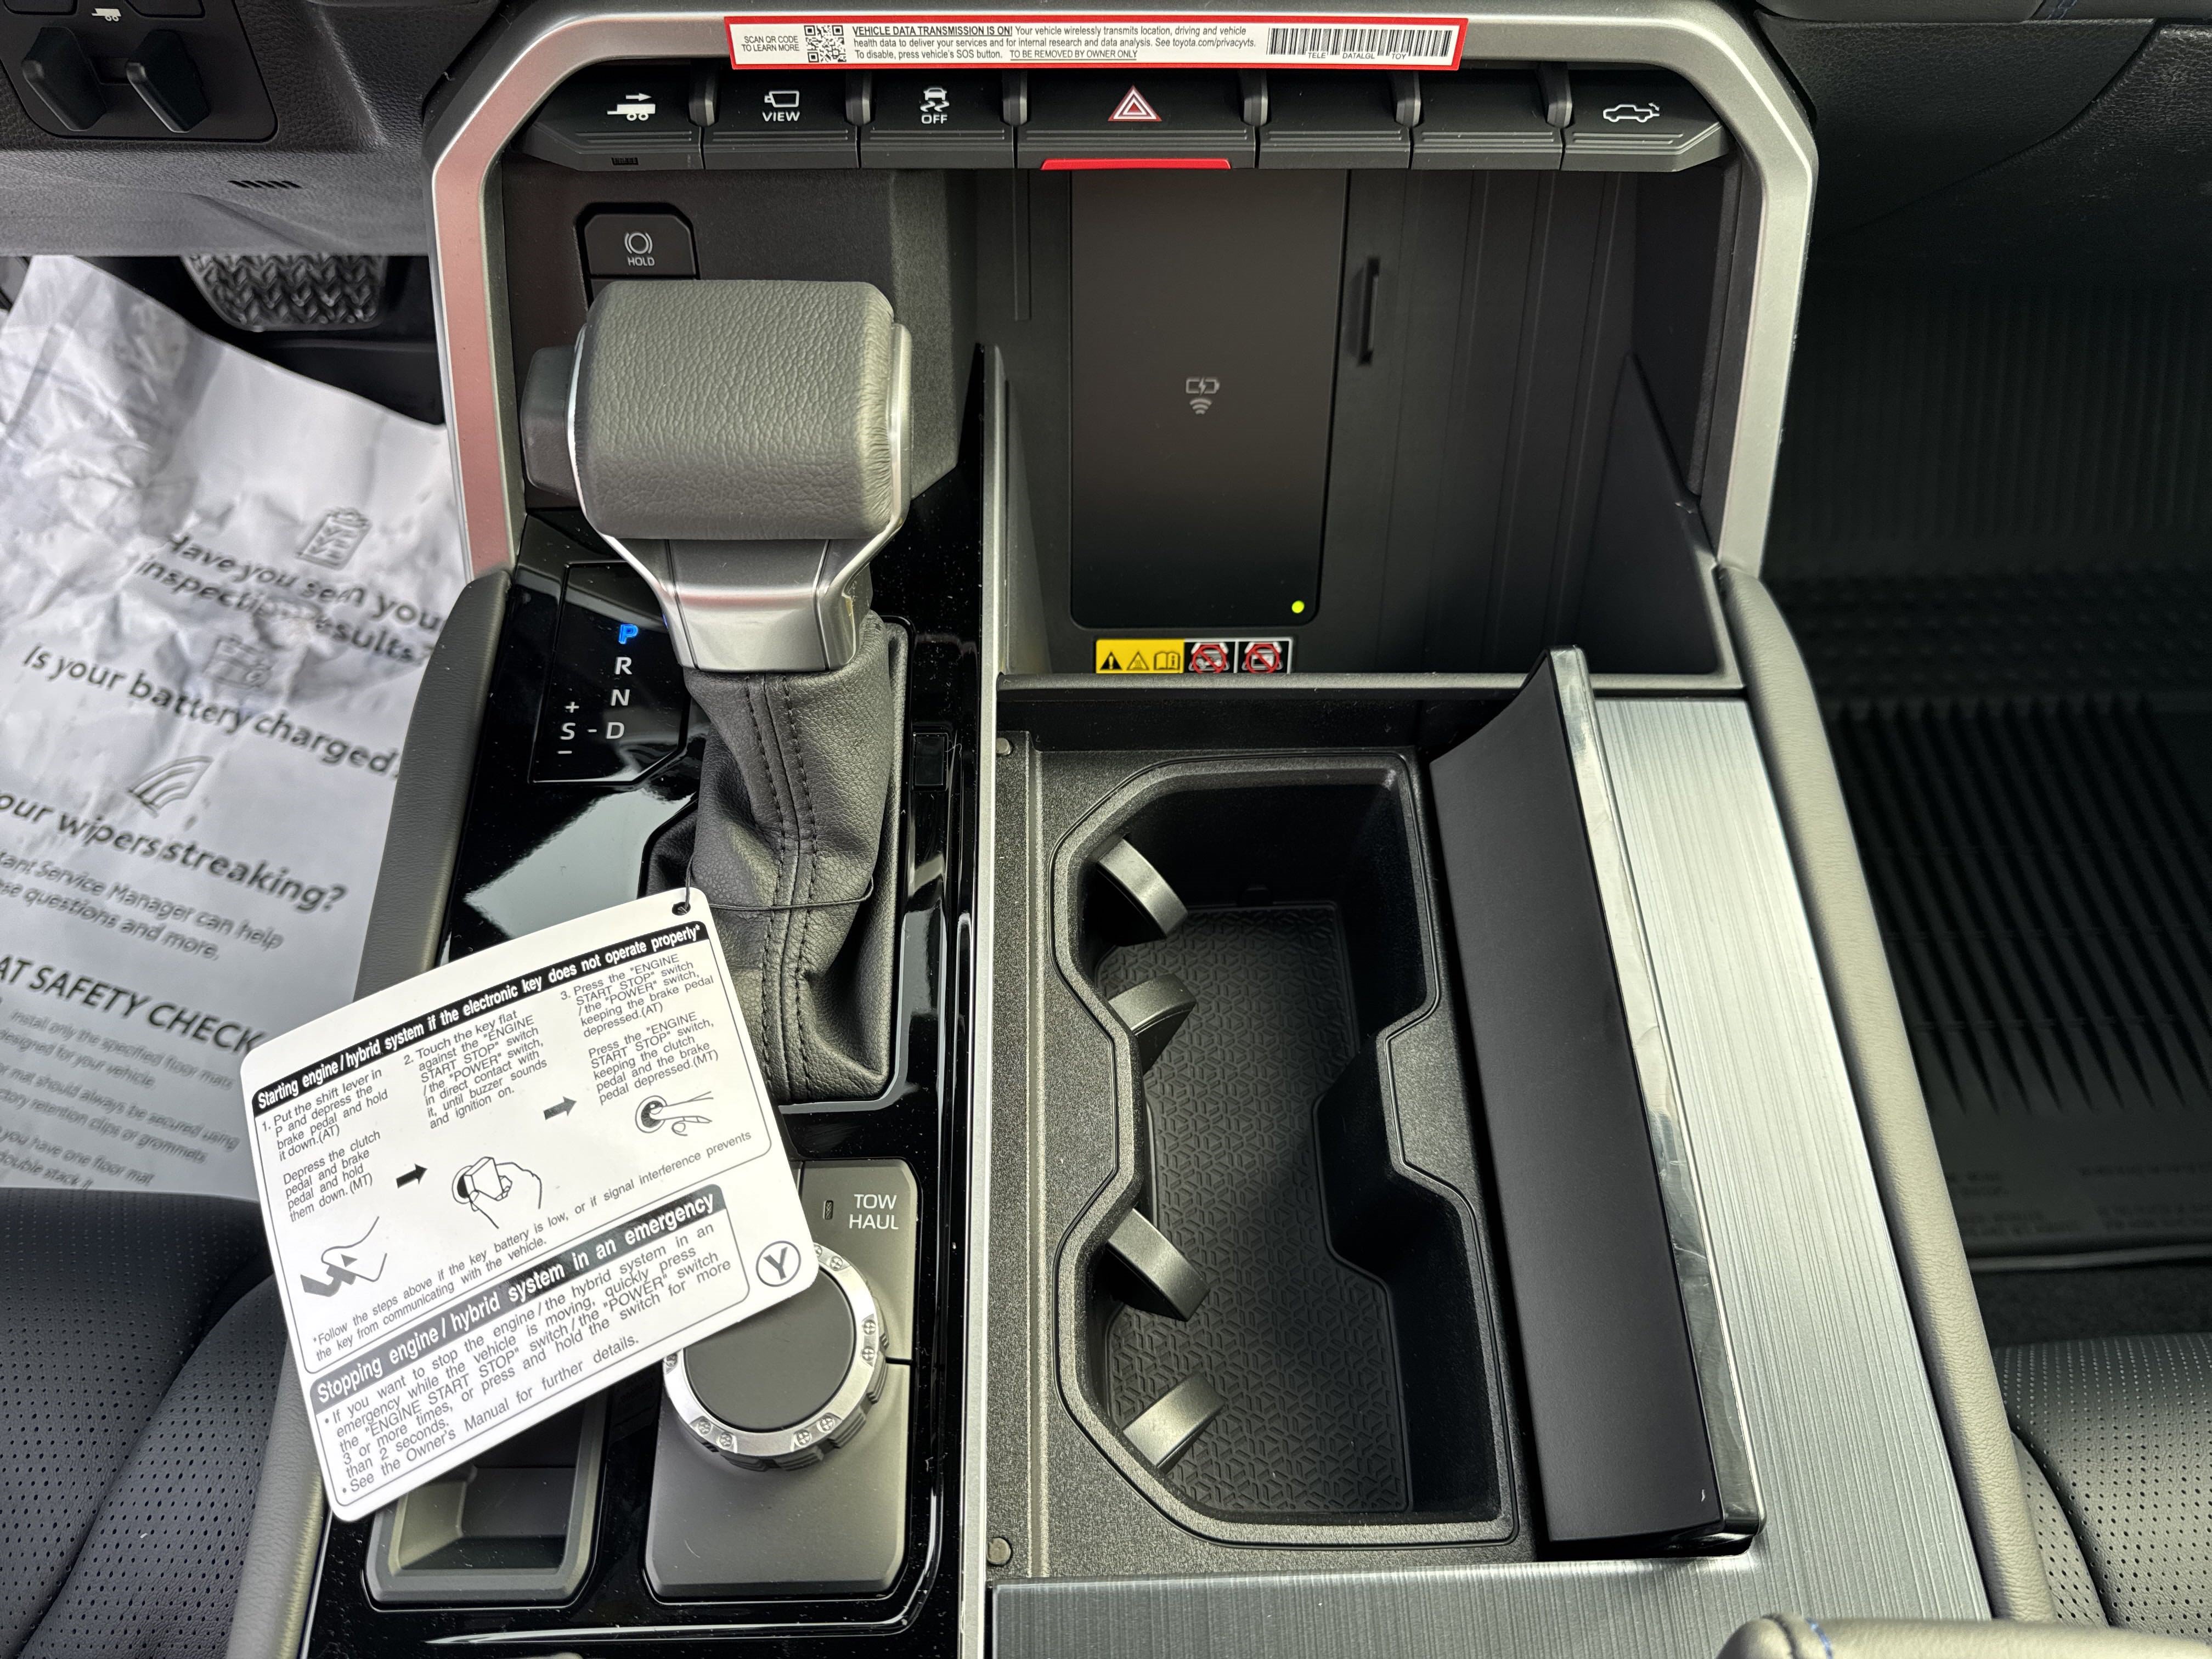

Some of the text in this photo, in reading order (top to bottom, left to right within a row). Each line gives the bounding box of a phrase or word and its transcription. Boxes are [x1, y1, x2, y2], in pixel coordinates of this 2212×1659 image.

[853, 26, 1246, 37] VEHICLE DATA TRANSMISSION IS ON! Your vehicle wirelessly transmits location, driving and vehicle
[854, 39, 877, 47] health
[880, 39, 896, 47] data
[899, 39, 906, 47] to
[910, 38, 934, 47] deliver
[938, 40, 953, 49] your
[990, 38, 1003, 47] and
[1006, 38, 1016, 47] for
[1019, 38, 1046, 47] internal
[1049, 38, 1081, 47] research
[1085, 38, 1098, 47] and
[1101, 38, 1117, 47] data
[1120, 38, 1152, 48] analysis.
[1155, 38, 1170, 47] See
[1173, 38, 1255, 48] toyota.com/privacyvts.
[856, 50, 864, 58] To
[867, 50, 896, 59] disable,
[899, 51, 919, 60] press
[922, 50, 953, 58] vehicle's
[957, 50, 974, 58] SOS
[977, 50, 1002, 58] button.
[762, 112, 799, 121] VIEW
[921, 114, 947, 124] OFF
[628, 257, 654, 267] HOLD
[618, 624, 639, 644] P
[614, 657, 632, 675] R
[48, 656, 126, 691] your
[129, 669, 253, 733] battery
[610, 689, 630, 706] N
[58, 811, 164, 859] wipers
[163, 840, 348, 913] streaking?
[109, 883, 195, 921] Manager
[196, 911, 233, 935] can
[29, 964, 150, 1019] SAFETY
[561, 953, 679, 1000] 3. Press the "ENGINE
[576, 961, 693, 1006] START STOP" switch
[258, 1080, 299, 1109] Starting
[385, 1024, 424, 1051] system
[427, 1014, 436, 1031] if
[439, 1009, 459, 1025] the
[463, 985, 518, 1016] electronic
[521, 976, 541, 993] key
[548, 964, 577, 983] does
[581, 954, 601, 972] not
[605, 941, 647, 964] operate
[404, 1010, 517, 1065] 2. Touch the key flat
[419, 1015, 534, 1071] against the "ENGINE
[421, 1027, 539, 1083] START STOP" switch
[593, 1035, 695, 1080] keeping the clutch
[262, 1069, 382, 1131] 1. Put the shift lever in
[275, 1086, 373, 1138] P and depress the
[849, 1214, 899, 1229] HAUL
[853, 1194, 898, 1209] TOW
[764, 1246, 788, 1279] Y
[318, 1358, 383, 1403] Stopping
[506, 1264, 565, 1302] system
[572, 1252, 589, 1271] in
[596, 1239, 617, 1260] an
[625, 1194, 713, 1245] emergency
[351, 1336, 639, 1492] See the Owner's Manual for further details.
[346, 1419, 449, 1478] than 2 seconds.
